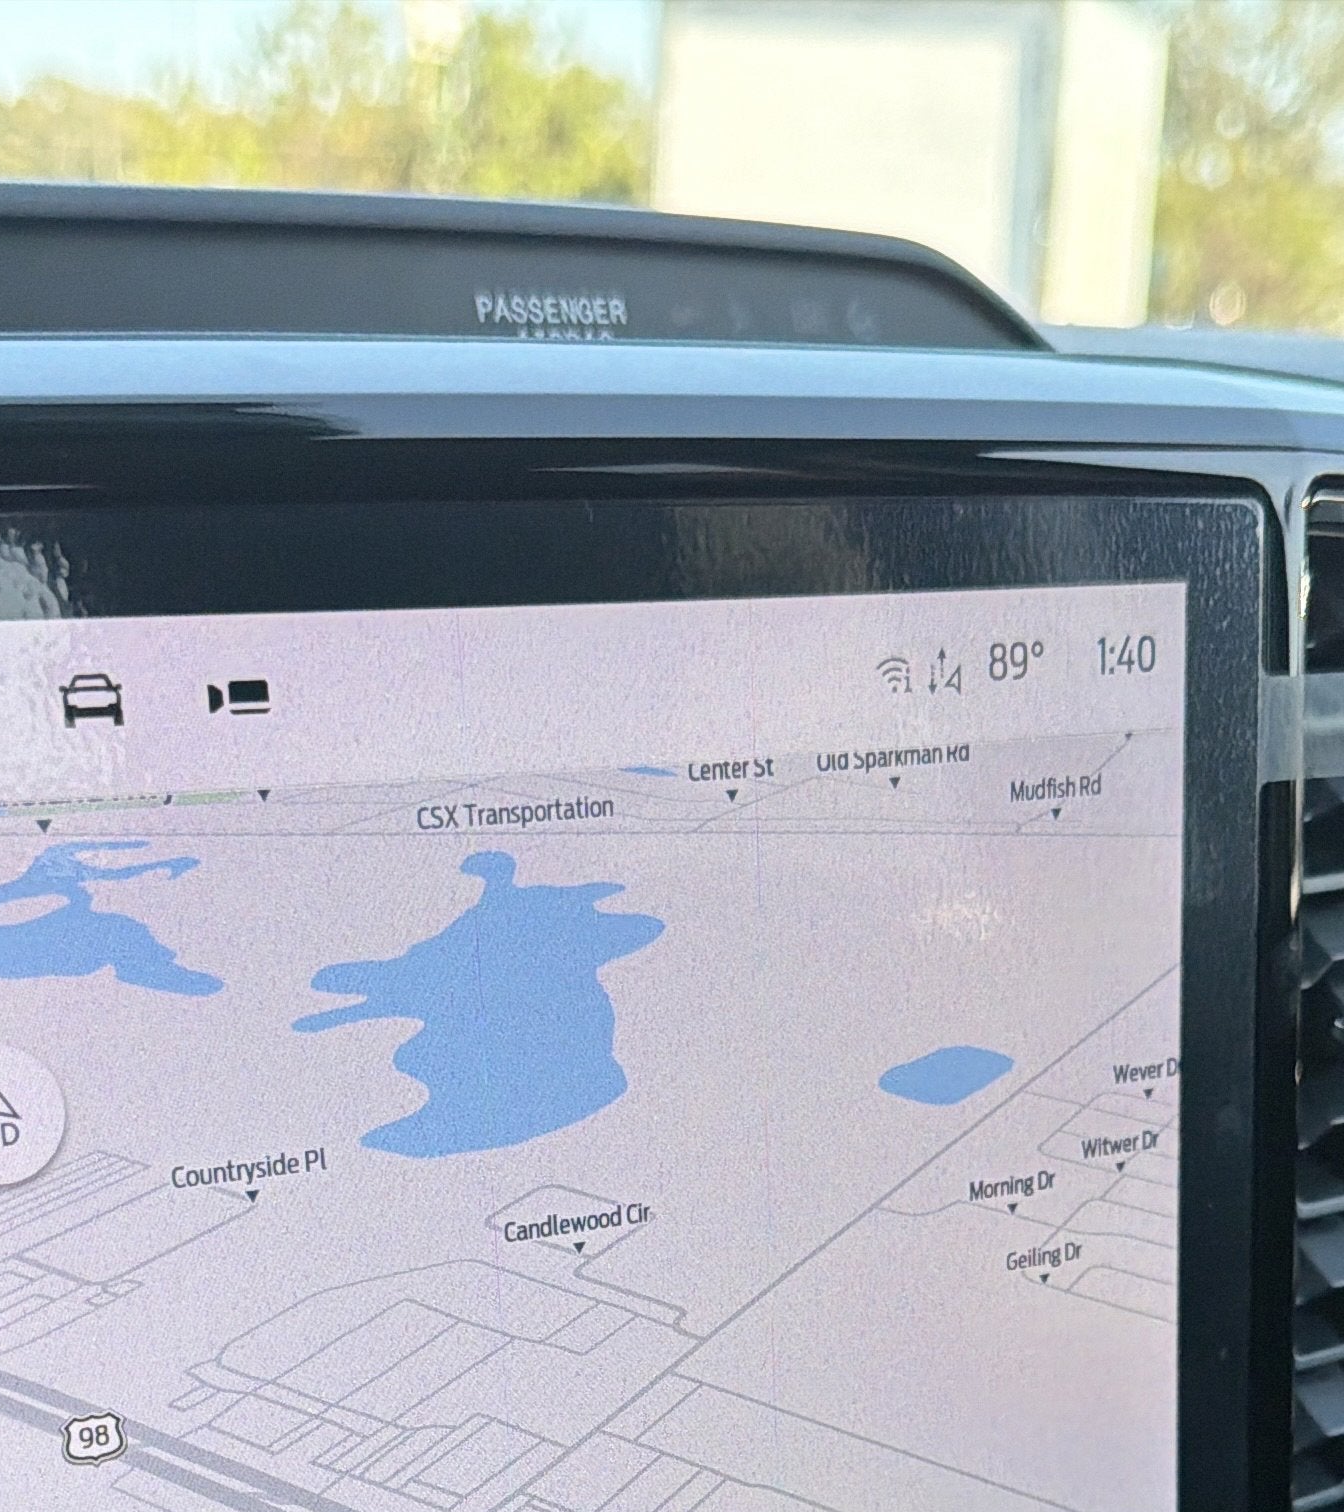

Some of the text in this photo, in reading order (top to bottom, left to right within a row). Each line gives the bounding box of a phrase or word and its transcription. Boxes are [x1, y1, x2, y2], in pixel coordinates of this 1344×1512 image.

[474, 293, 628, 325] PASSENGER
[988, 640, 1044, 682] 89°
[1096, 634, 1156, 676] 1:40
[688, 758, 774, 782] Center St
[853, 749, 942, 773] Sparkman
[1010, 773, 1102, 802] Mudfish Rd
[416, 796, 614, 830] CSX Transportation
[1113, 1065, 1162, 1084] Wever
[1081, 1130, 1160, 1159] Witwer Dr
[171, 1147, 328, 1189] Countryside Pl
[969, 1170, 1056, 1201] Morning Dr
[504, 1202, 651, 1243] Candlewood Cir
[1006, 1242, 1082, 1270] Geiling Dr
[78, 1424, 110, 1449] 98
